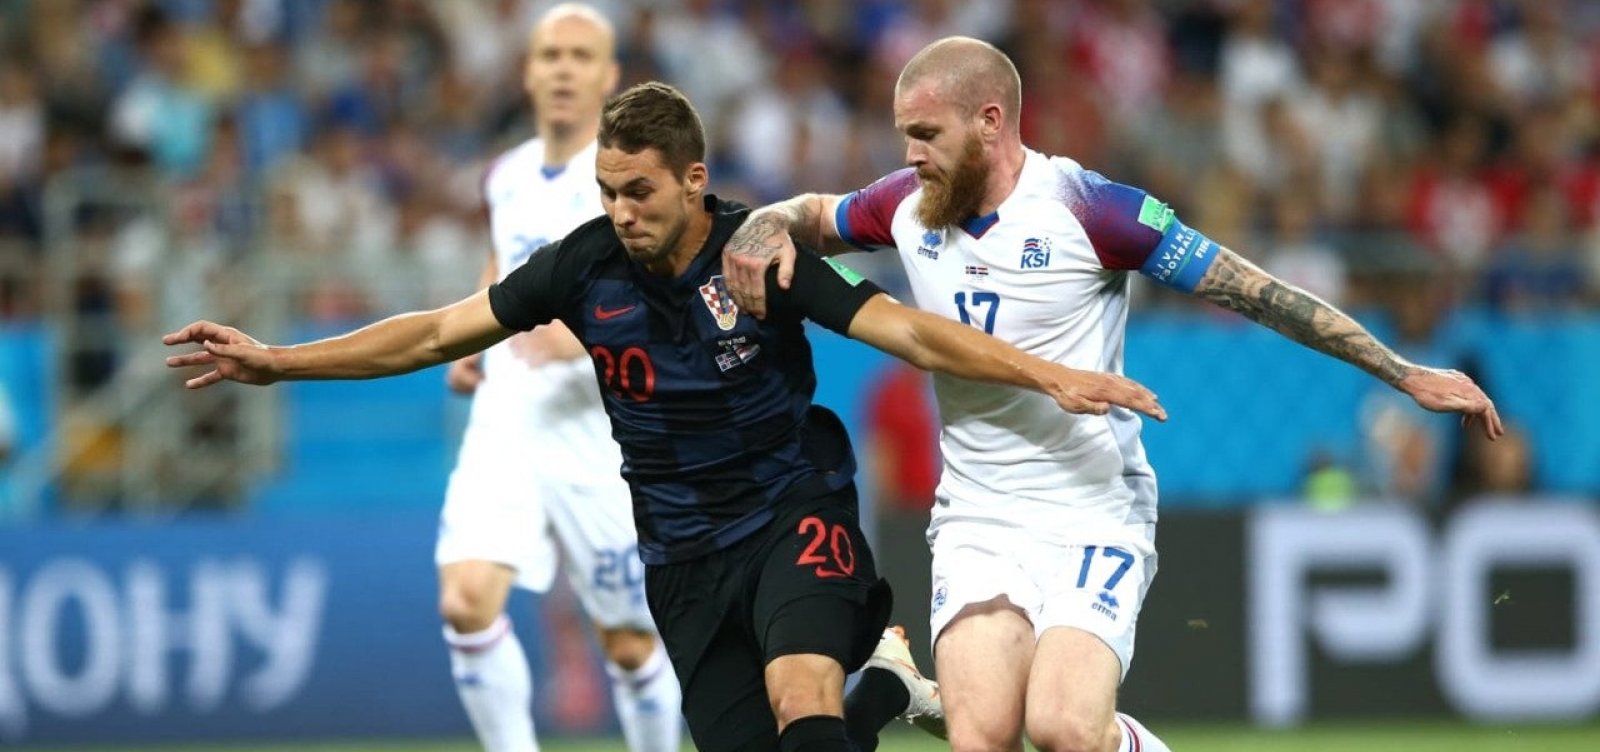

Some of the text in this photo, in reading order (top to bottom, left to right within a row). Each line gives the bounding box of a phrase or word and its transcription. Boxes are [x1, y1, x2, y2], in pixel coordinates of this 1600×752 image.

[954, 291, 1000, 335] 17
[590, 345, 656, 402] 20
[796, 516, 855, 576] 20
[1076, 545, 1135, 591] 17
